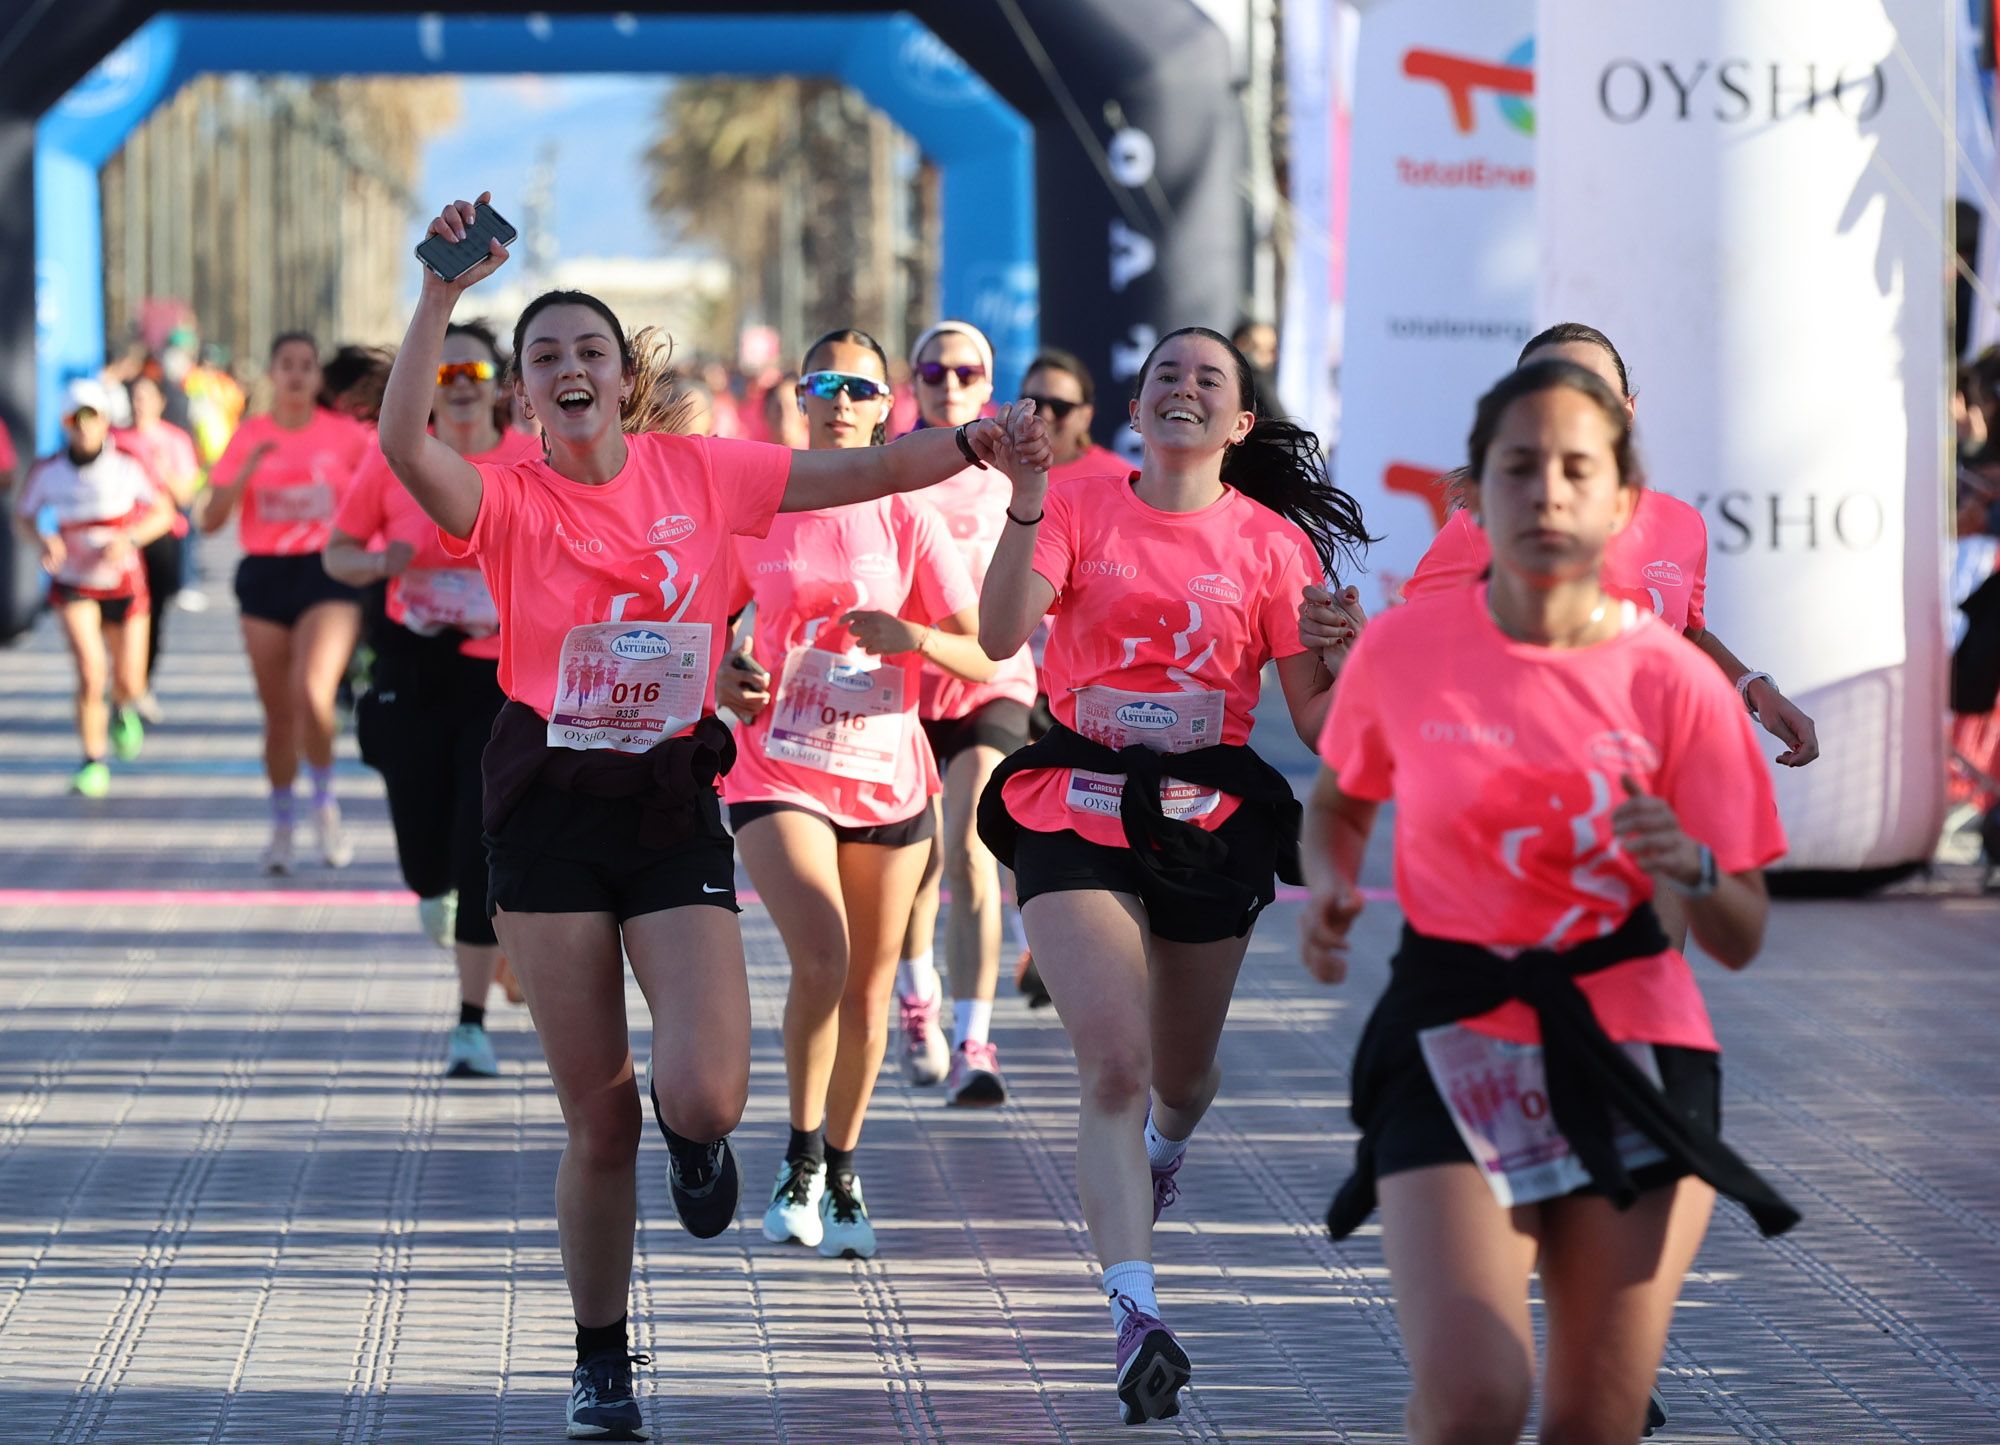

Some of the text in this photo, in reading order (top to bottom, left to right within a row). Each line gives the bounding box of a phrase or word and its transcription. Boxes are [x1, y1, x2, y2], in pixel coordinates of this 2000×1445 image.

[1597, 57, 1886, 124] OYSHO
[1696, 490, 1884, 554] SHO
[652, 523, 693, 543] ASTURIANA
[1080, 560, 1138, 580] OYSHO
[1190, 580, 1238, 601] ASTURIANA
[615, 640, 667, 655] ASTURIANA
[611, 682, 661, 704] 016
[615, 709, 640, 719] 9336
[821, 706, 867, 731] 016
[1120, 709, 1174, 724] ASTURIANA
[571, 718, 600, 728] CARRERA
[620, 721, 642, 729] MUJER
[564, 730, 606, 744] OYSHO
[1089, 783, 1117, 794] CARRERA
[1171, 788, 1201, 798] VALENCIA
[1083, 797, 1122, 812] OYSH
